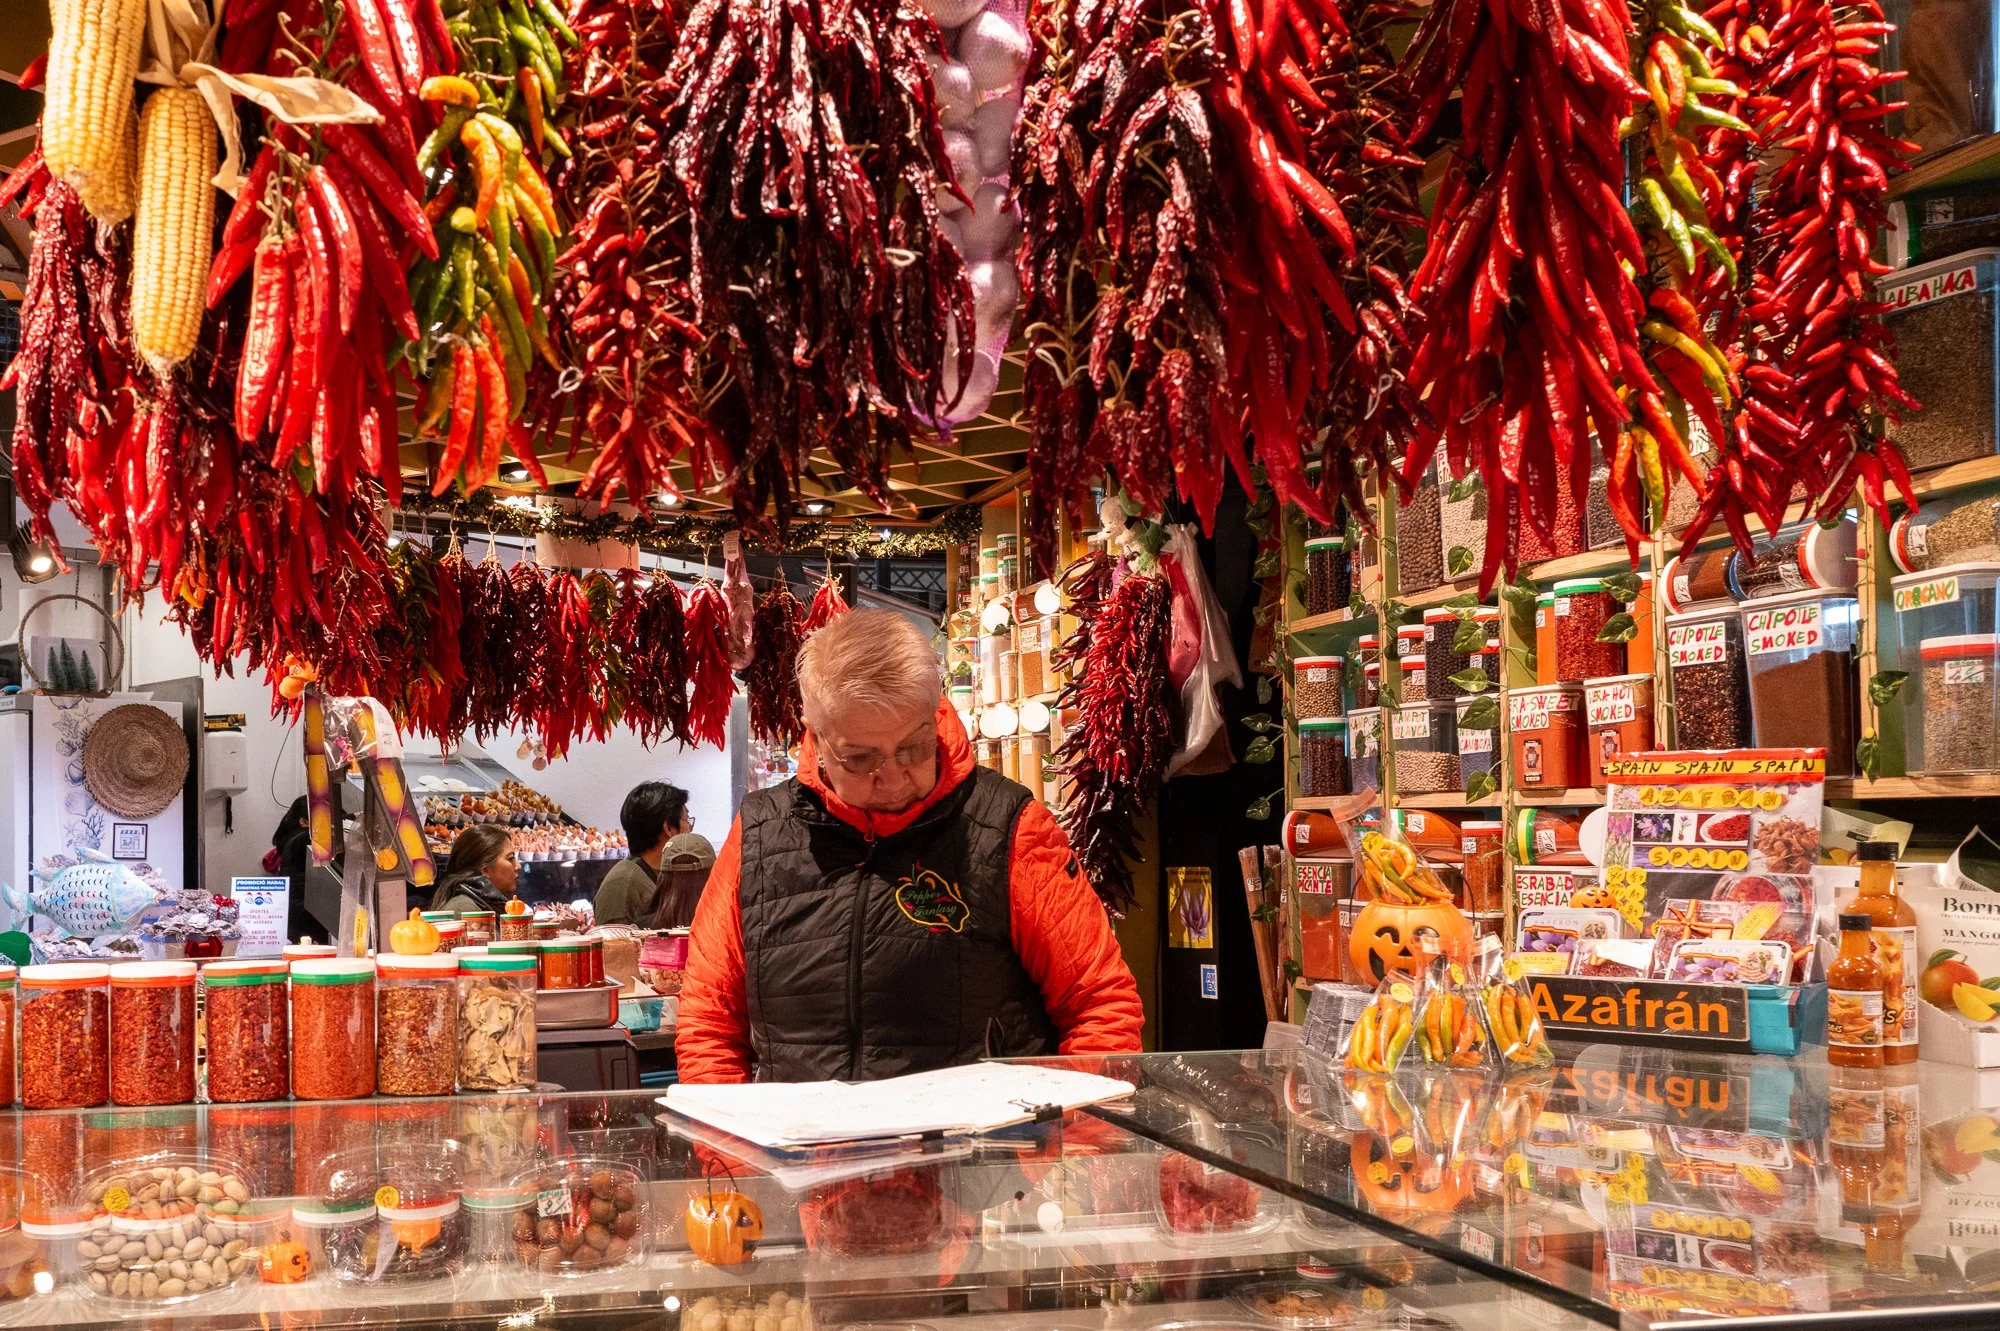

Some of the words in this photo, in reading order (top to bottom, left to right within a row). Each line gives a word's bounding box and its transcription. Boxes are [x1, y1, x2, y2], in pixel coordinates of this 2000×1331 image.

[1888, 269, 1975, 307] ALBAHACA
[1896, 579, 1955, 610] OREGANO
[1748, 605, 1820, 632] CHIPOTLE
[1668, 624, 1724, 646] CHIPOTLE
[1751, 629, 1818, 653] SMOKED
[1671, 645, 1723, 665] SMOKED
[1511, 712, 1547, 730] SMOKED
[1590, 703, 1633, 723] SMOKED
[1610, 760, 1662, 777] SPAIN
[1674, 757, 1735, 775] SPAIN
[1749, 758, 1815, 774] SPAIN
[1653, 849, 1745, 867] SPAIN
[1297, 866, 1332, 879] ESENCIA
[1297, 879, 1332, 894] PICANTE
[1515, 875, 1574, 891] ESRABAD
[1521, 892, 1569, 906] ESENCIA
[1941, 929, 2000, 940] MANGO
[1531, 982, 1730, 1034] Azafrán
